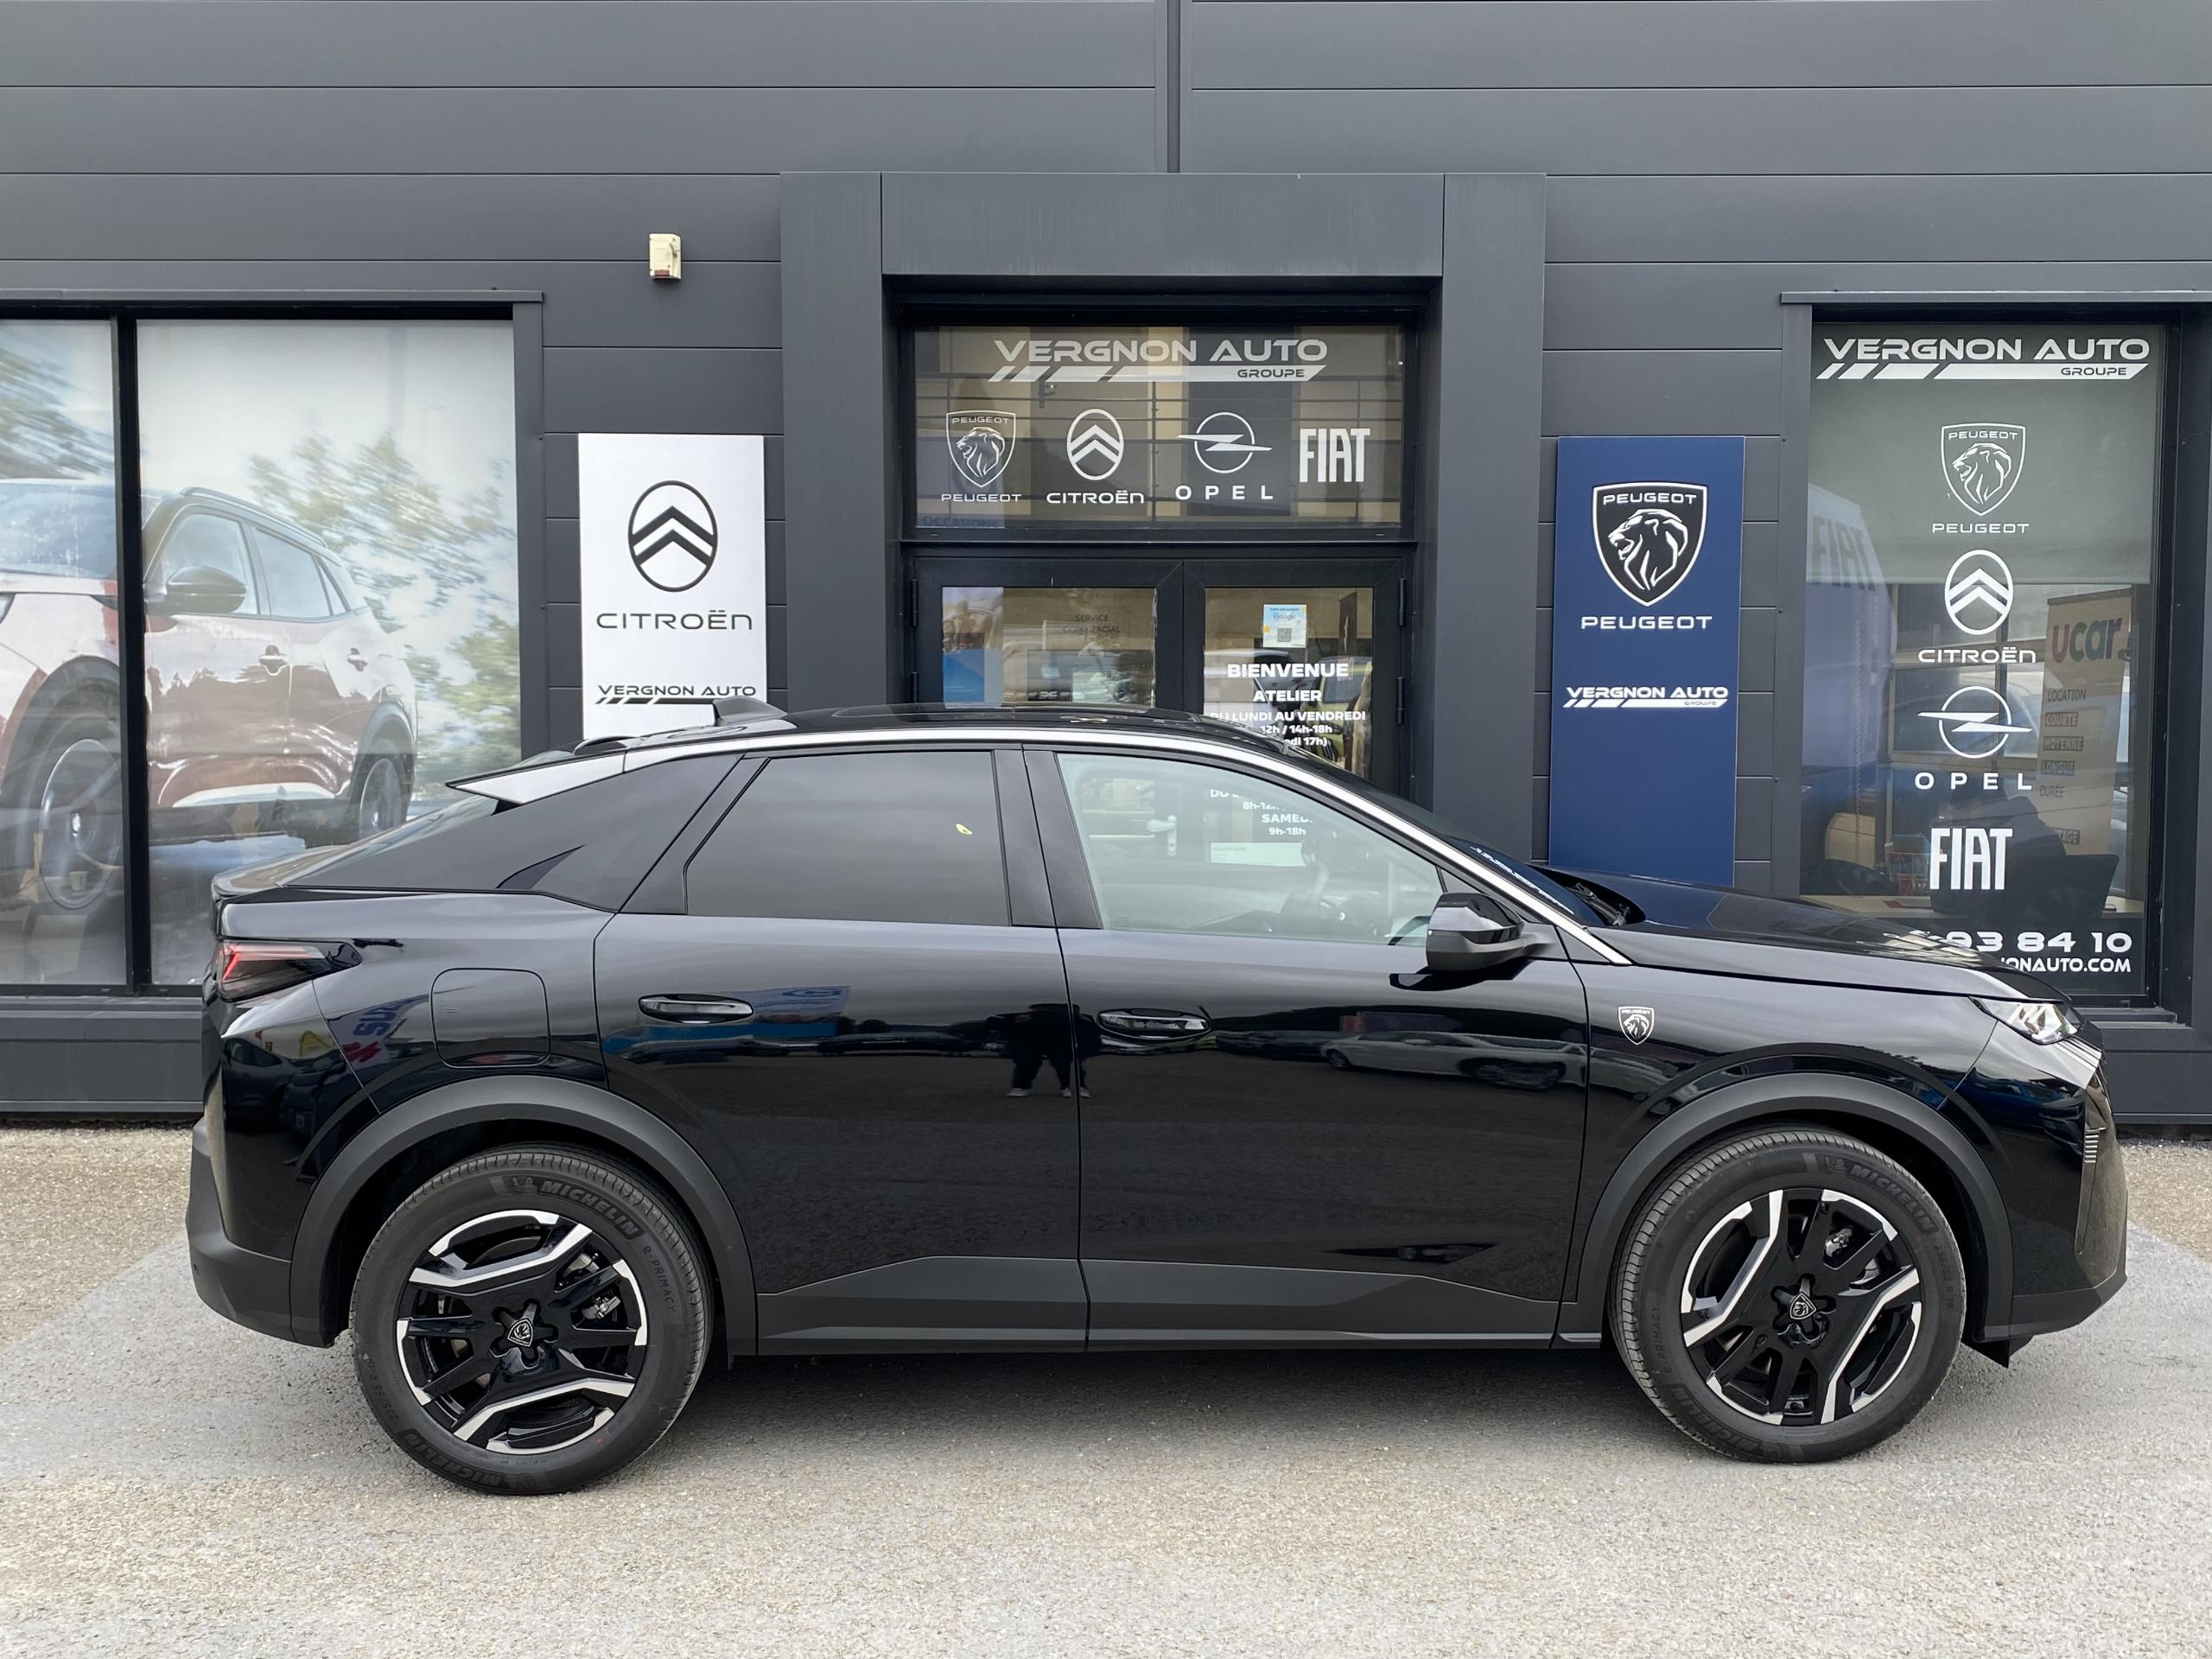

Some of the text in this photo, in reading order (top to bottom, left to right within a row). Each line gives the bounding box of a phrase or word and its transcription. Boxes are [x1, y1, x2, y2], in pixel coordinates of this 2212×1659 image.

[994, 339, 1328, 362] VERGNON AUTO
[1823, 338, 2150, 360] VERGNON AUTO
[1237, 368, 1306, 378] GROUPE
[2060, 366, 2127, 377] GROUPE
[951, 416, 1010, 426] PEUGEOT
[1948, 430, 2018, 441] PEUGEOT
[1299, 428, 1371, 483] FIAT
[940, 493, 1022, 503] PEUGEOT
[1046, 489, 1145, 505] CITROËN
[1175, 485, 1274, 501] OPEL
[1602, 492, 1697, 505] PEUGEOT
[1931, 523, 2031, 534] PEUGEOT
[596, 610, 753, 631] CITROËN
[1074, 613, 1109, 622] SERVICE
[1580, 616, 1713, 630] PEUGEOT
[1917, 646, 2037, 664] CITROËN
[1226, 663, 1350, 678] BIENVENUE
[597, 684, 757, 696] VERGNON AUTO
[1252, 690, 1323, 702] ATELIER
[1565, 686, 1729, 699] VERGNON AUTO
[2047, 688, 2087, 702] LOCATION
[1232, 711, 1273, 722] LUNDI
[1274, 711, 1296, 721] AU
[1296, 710, 1366, 721] VENDREDI
[2045, 712, 2077, 727] COURTE
[1289, 724, 1333, 734] 14h-18h
[1303, 737, 1328, 747] 17h)
[2044, 737, 2083, 751] MOYENNE
[2042, 761, 2075, 774] LONGUE
[1914, 772, 2032, 791] OPEL
[1268, 827, 1306, 836] 9h-18h
[1929, 828, 2013, 891] FIAT
[2016, 931, 2076, 953] 84
[2089, 931, 2133, 953] 10
[2000, 957, 2132, 973] ONAUTO.COM
[1850, 1164, 1938, 1235] MICHELIN
[538, 1180, 642, 1239] MICHELIN
